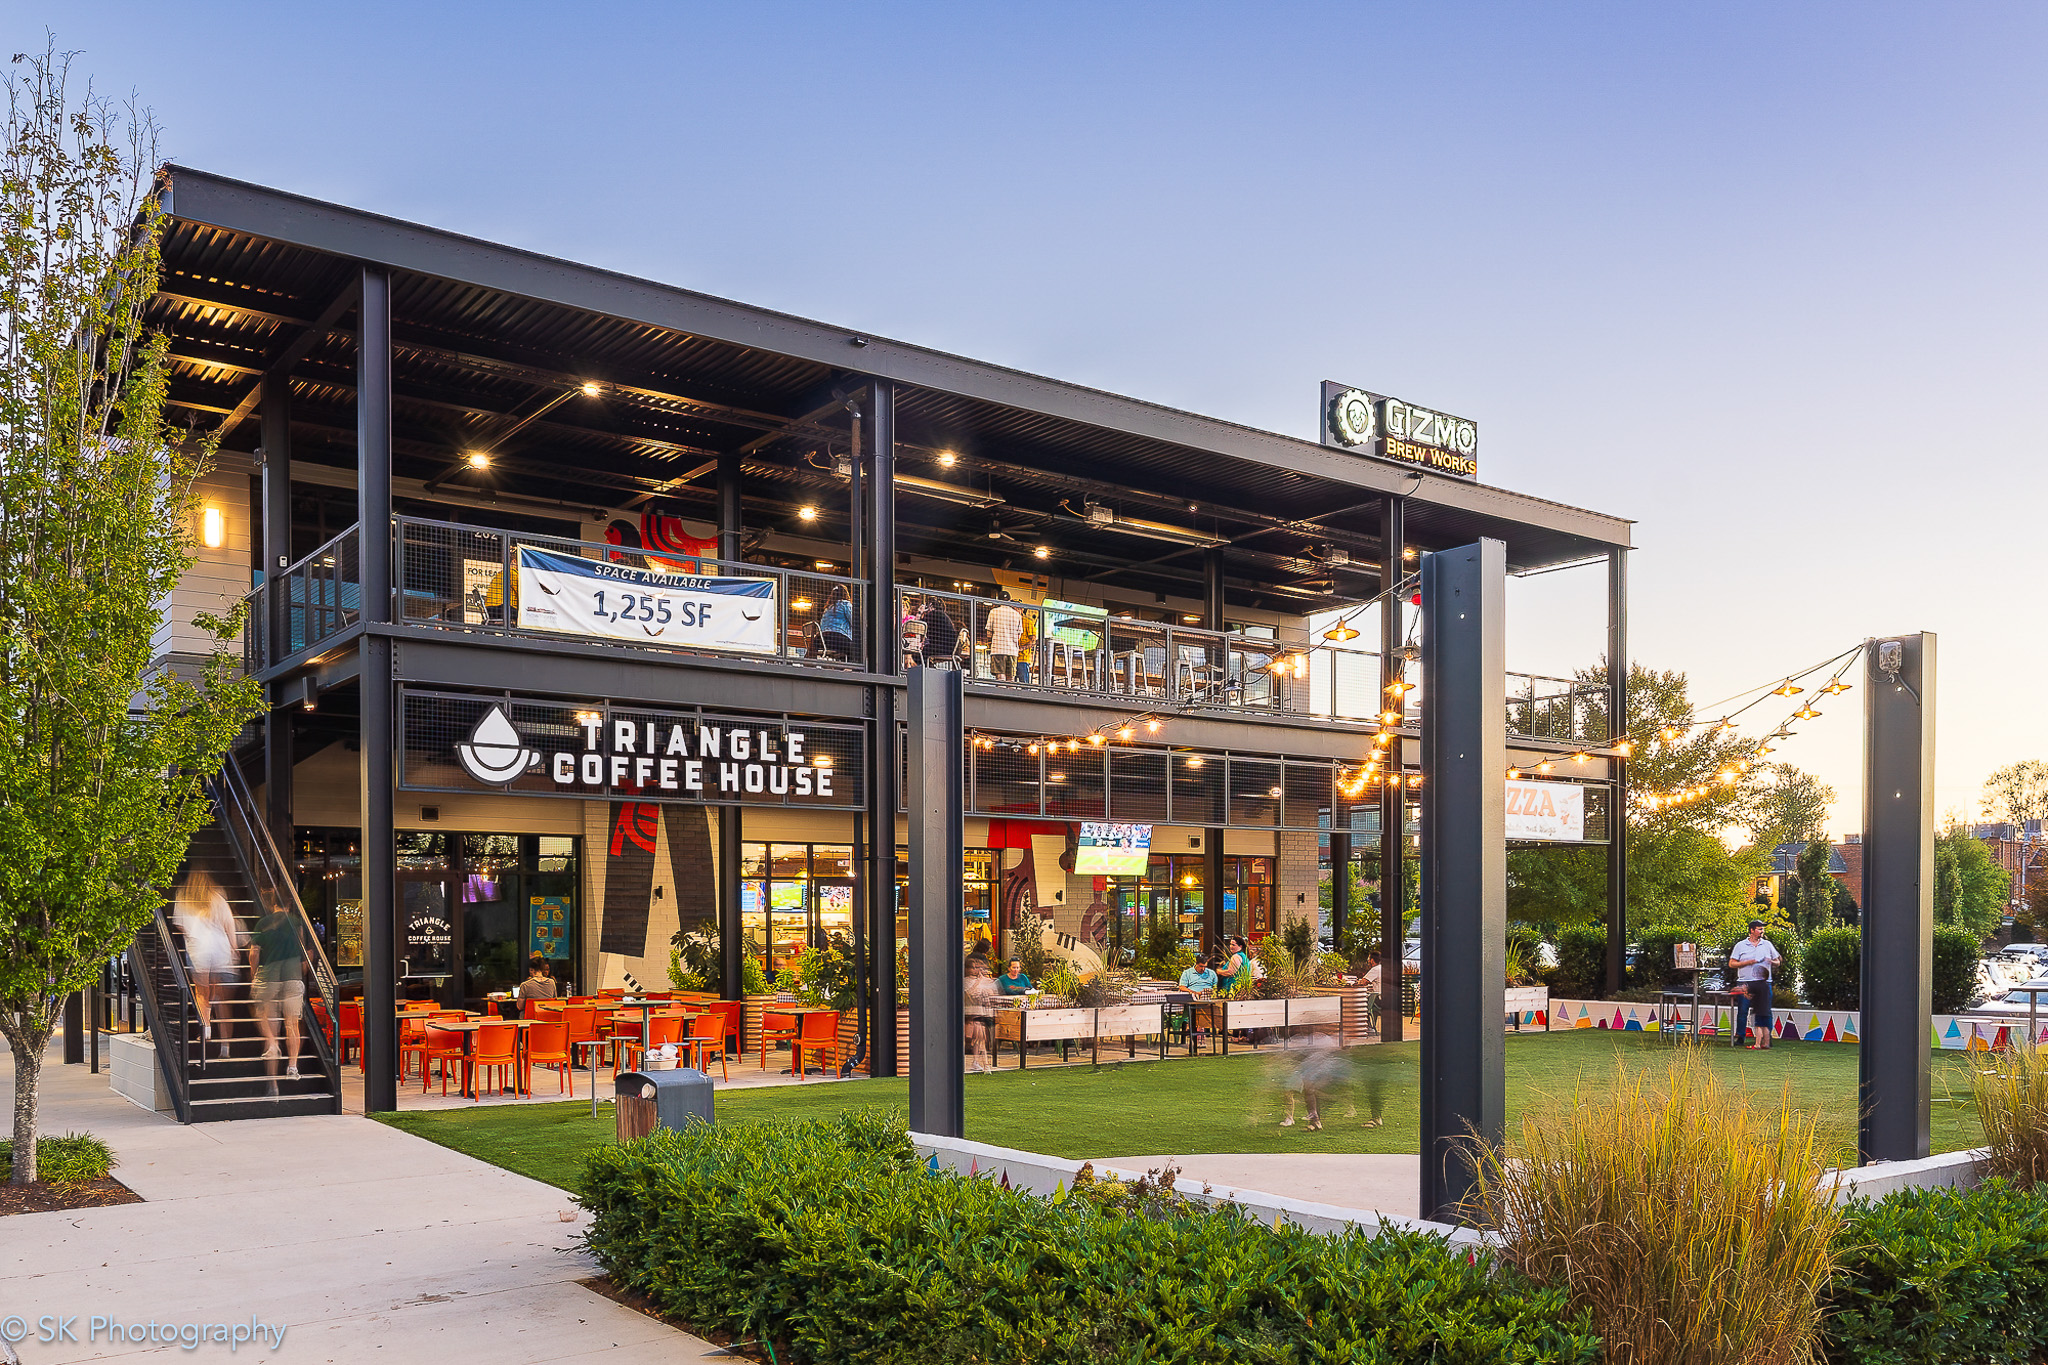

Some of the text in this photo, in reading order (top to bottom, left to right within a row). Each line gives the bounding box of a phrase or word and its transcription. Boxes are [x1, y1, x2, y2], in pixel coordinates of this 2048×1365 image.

[1385, 398, 1476, 455] GIZMO
[1386, 437, 1477, 475] BREW WORKS
[467, 567, 483, 577] FOR
[594, 565, 712, 590] SPACE AVAILABLE
[593, 590, 672, 624] 1,255
[681, 601, 712, 628] SF
[581, 718, 806, 764] TRIANGLE
[553, 752, 833, 796] COFFEE HOUSE
[1506, 787, 1557, 817] ZZA
[408, 916, 451, 932] TRIANGLE
